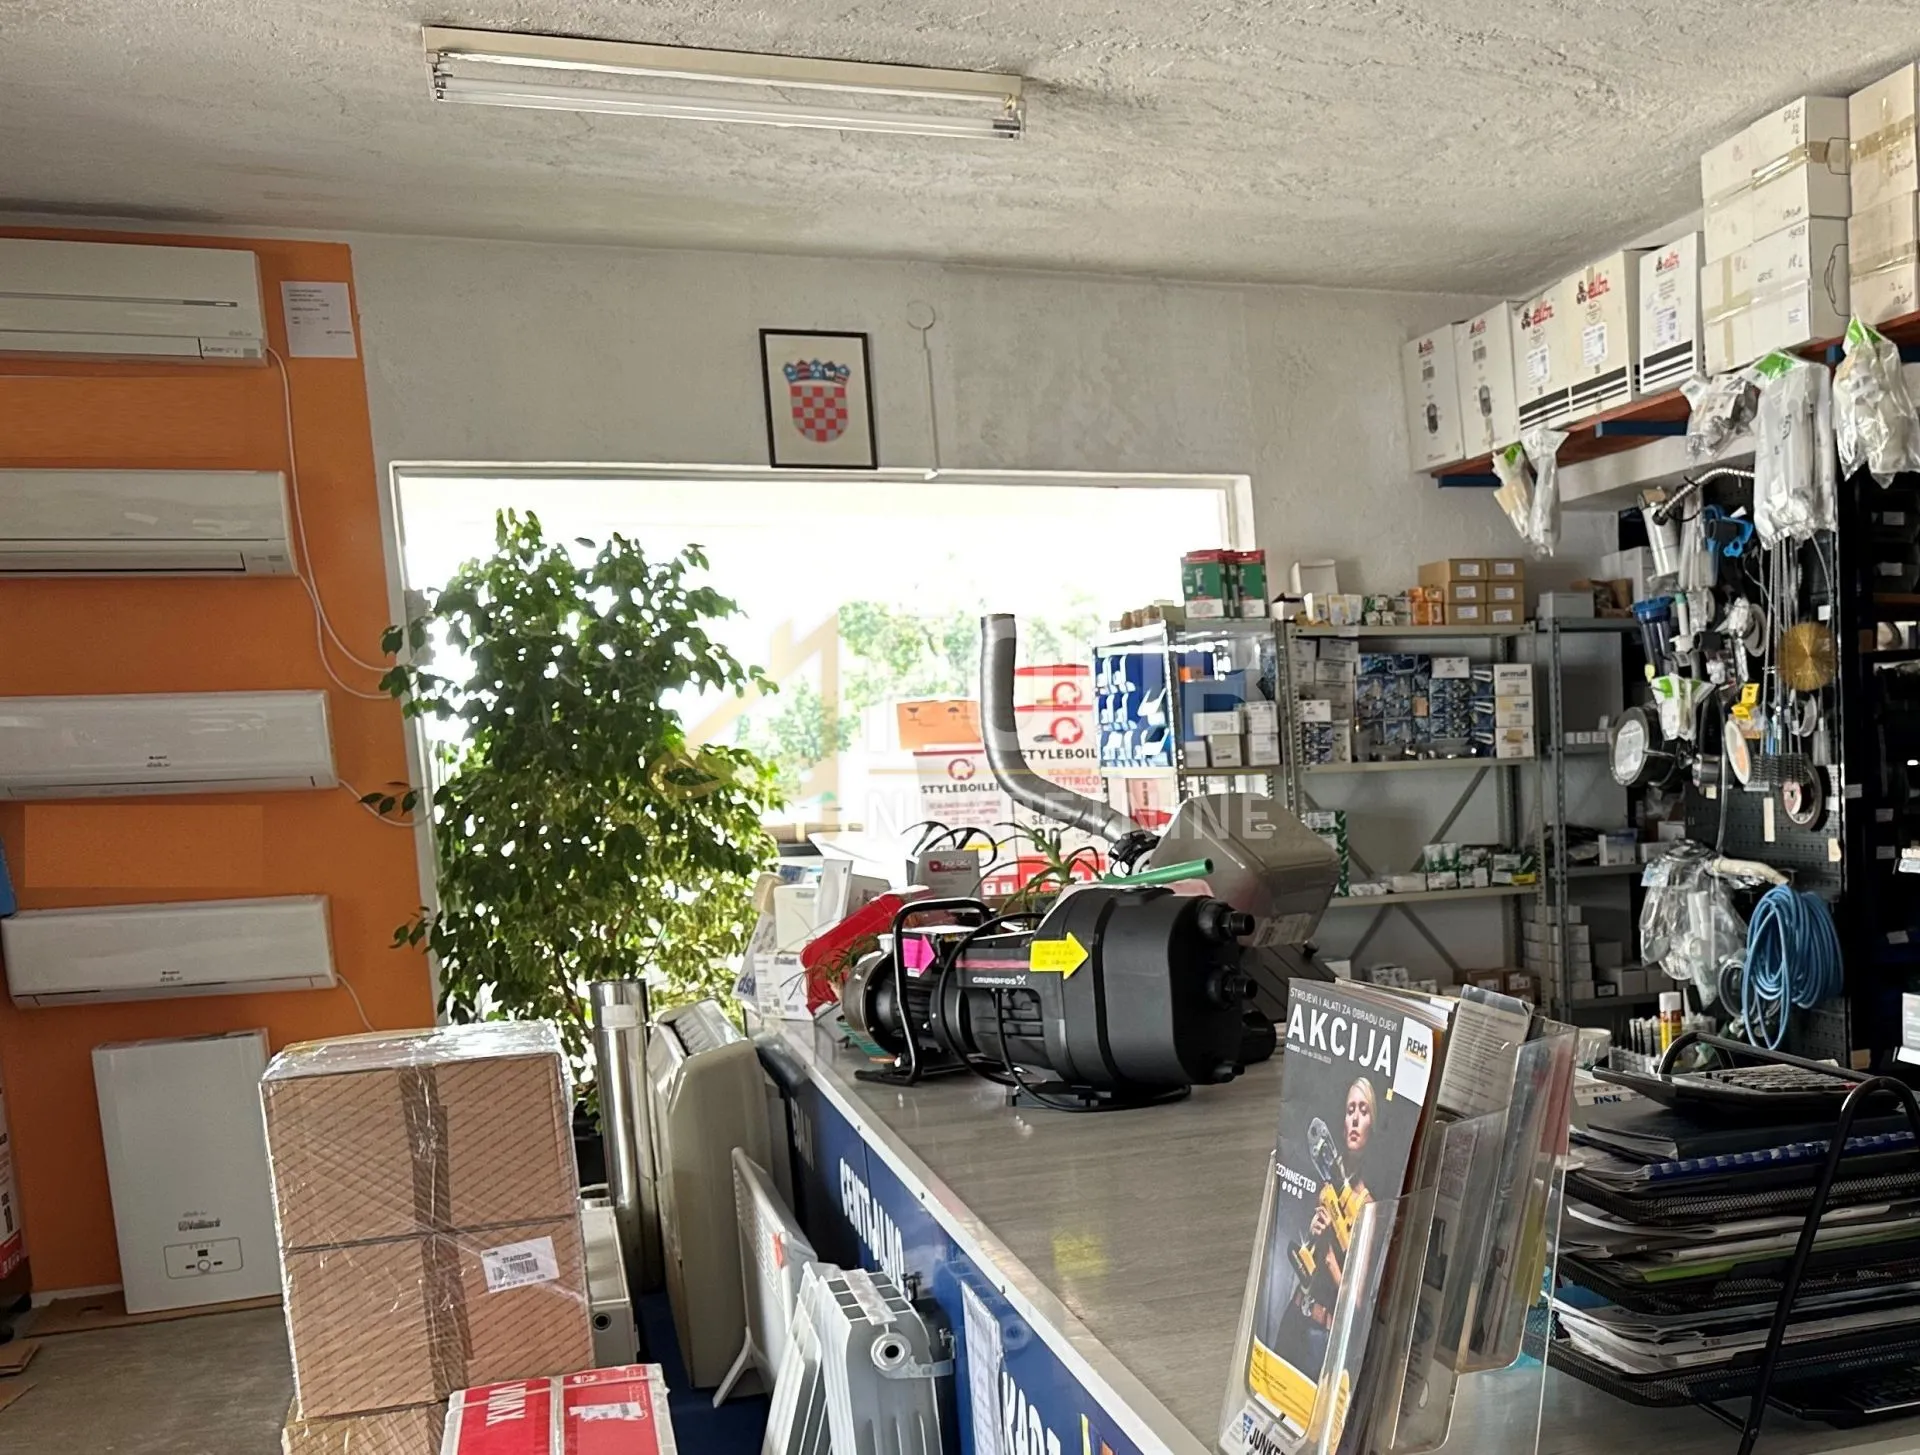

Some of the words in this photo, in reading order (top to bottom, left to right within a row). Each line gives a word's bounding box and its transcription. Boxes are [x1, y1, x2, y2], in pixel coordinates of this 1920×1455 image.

[972, 976, 1017, 985] GRUNDFOS
[1290, 988, 1319, 1007] STROJEVI
[1322, 998, 1341, 1013] ALATI
[1341, 1004, 1351, 1015] ZA
[1352, 1008, 1378, 1026] OBRADU
[1287, 1003, 1392, 1077] AKCIJA
[1406, 1036, 1428, 1058] REMS
